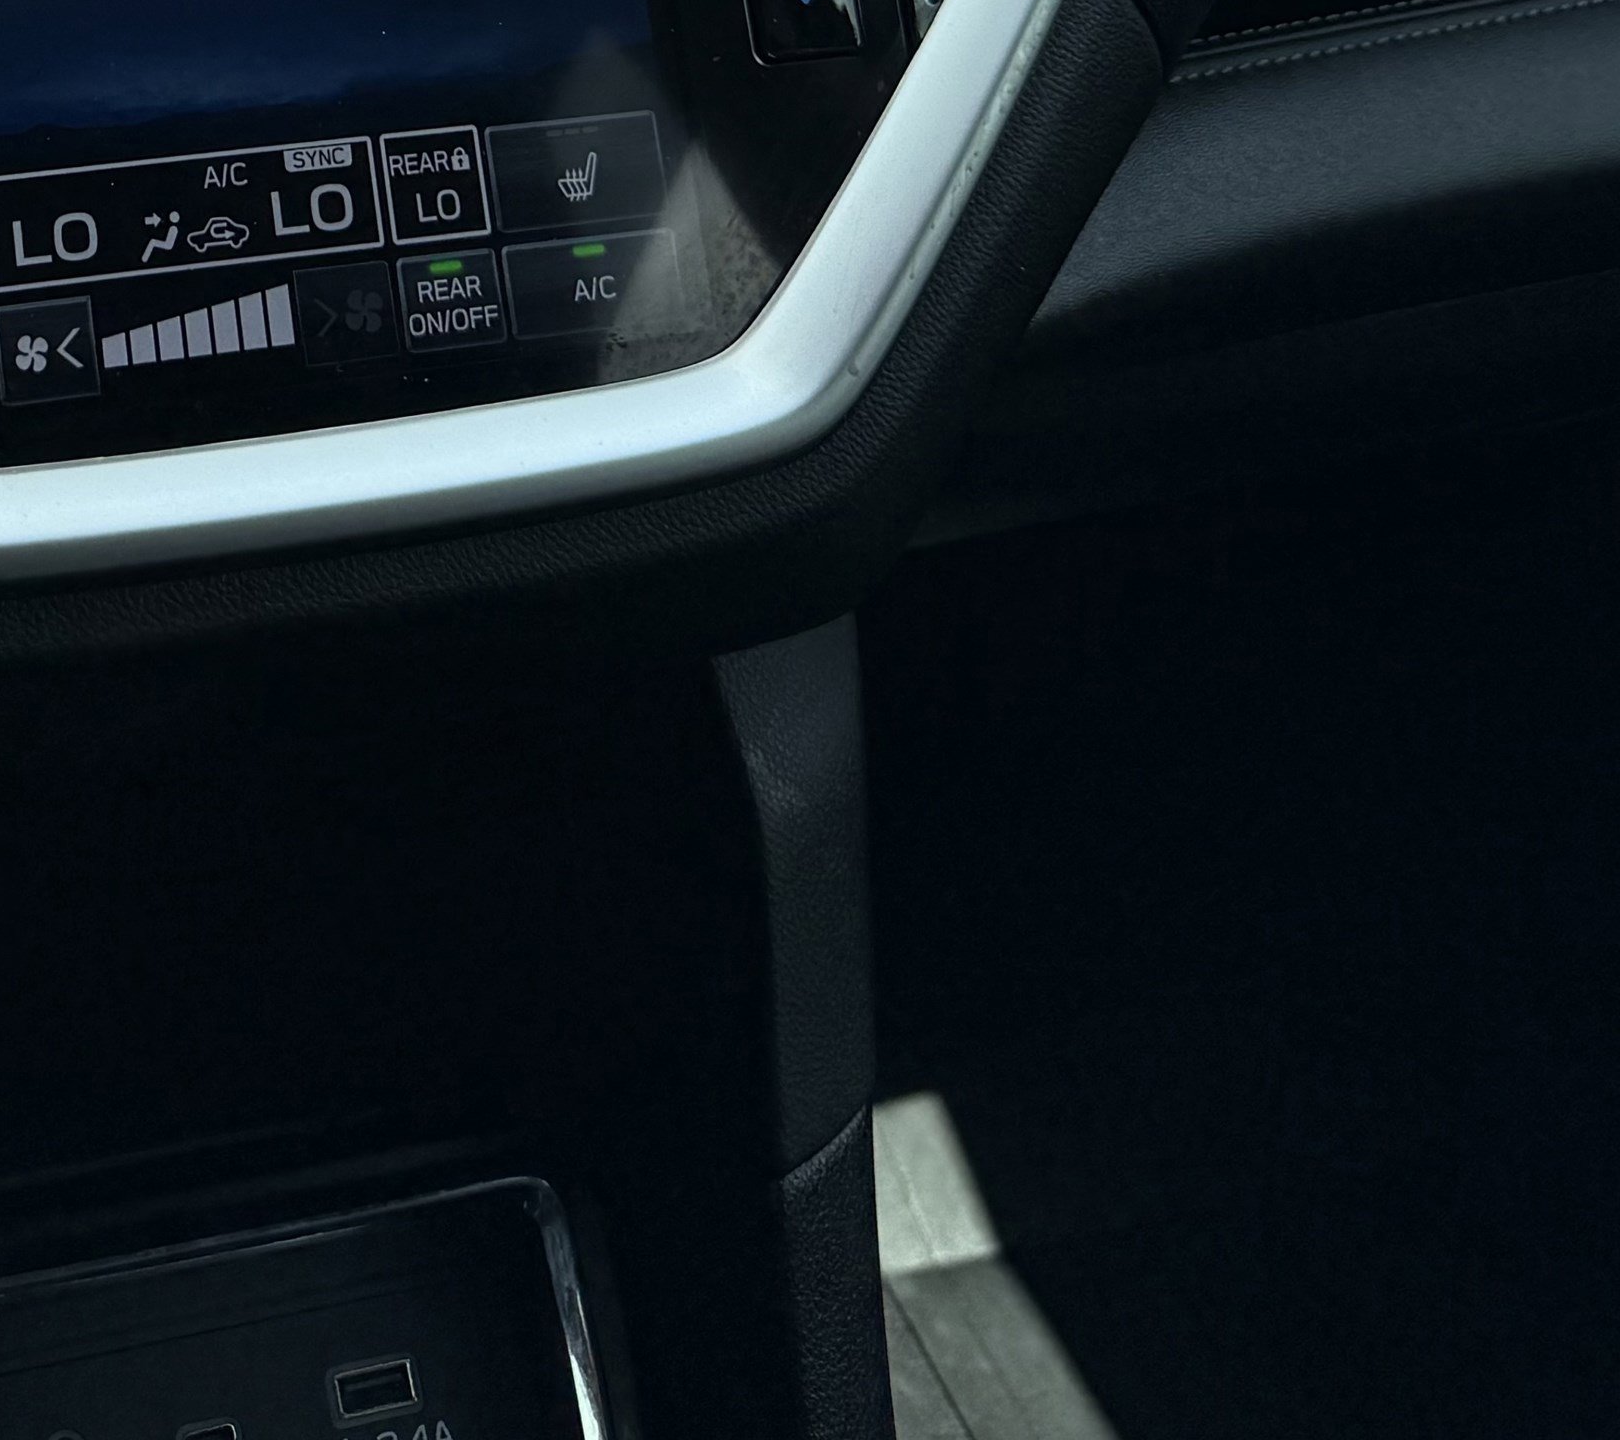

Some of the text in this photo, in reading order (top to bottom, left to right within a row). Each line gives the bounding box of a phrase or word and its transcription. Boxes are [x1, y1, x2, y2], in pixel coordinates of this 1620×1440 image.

[292, 148, 346, 170] SYNC
[388, 150, 450, 176] REAR
[203, 162, 248, 189] A/C
[270, 183, 354, 237] LO
[415, 188, 461, 223] LO
[12, 212, 98, 267] LO
[417, 275, 483, 303] REAR
[574, 275, 617, 302] A/C
[409, 304, 499, 337] ON/OFF
